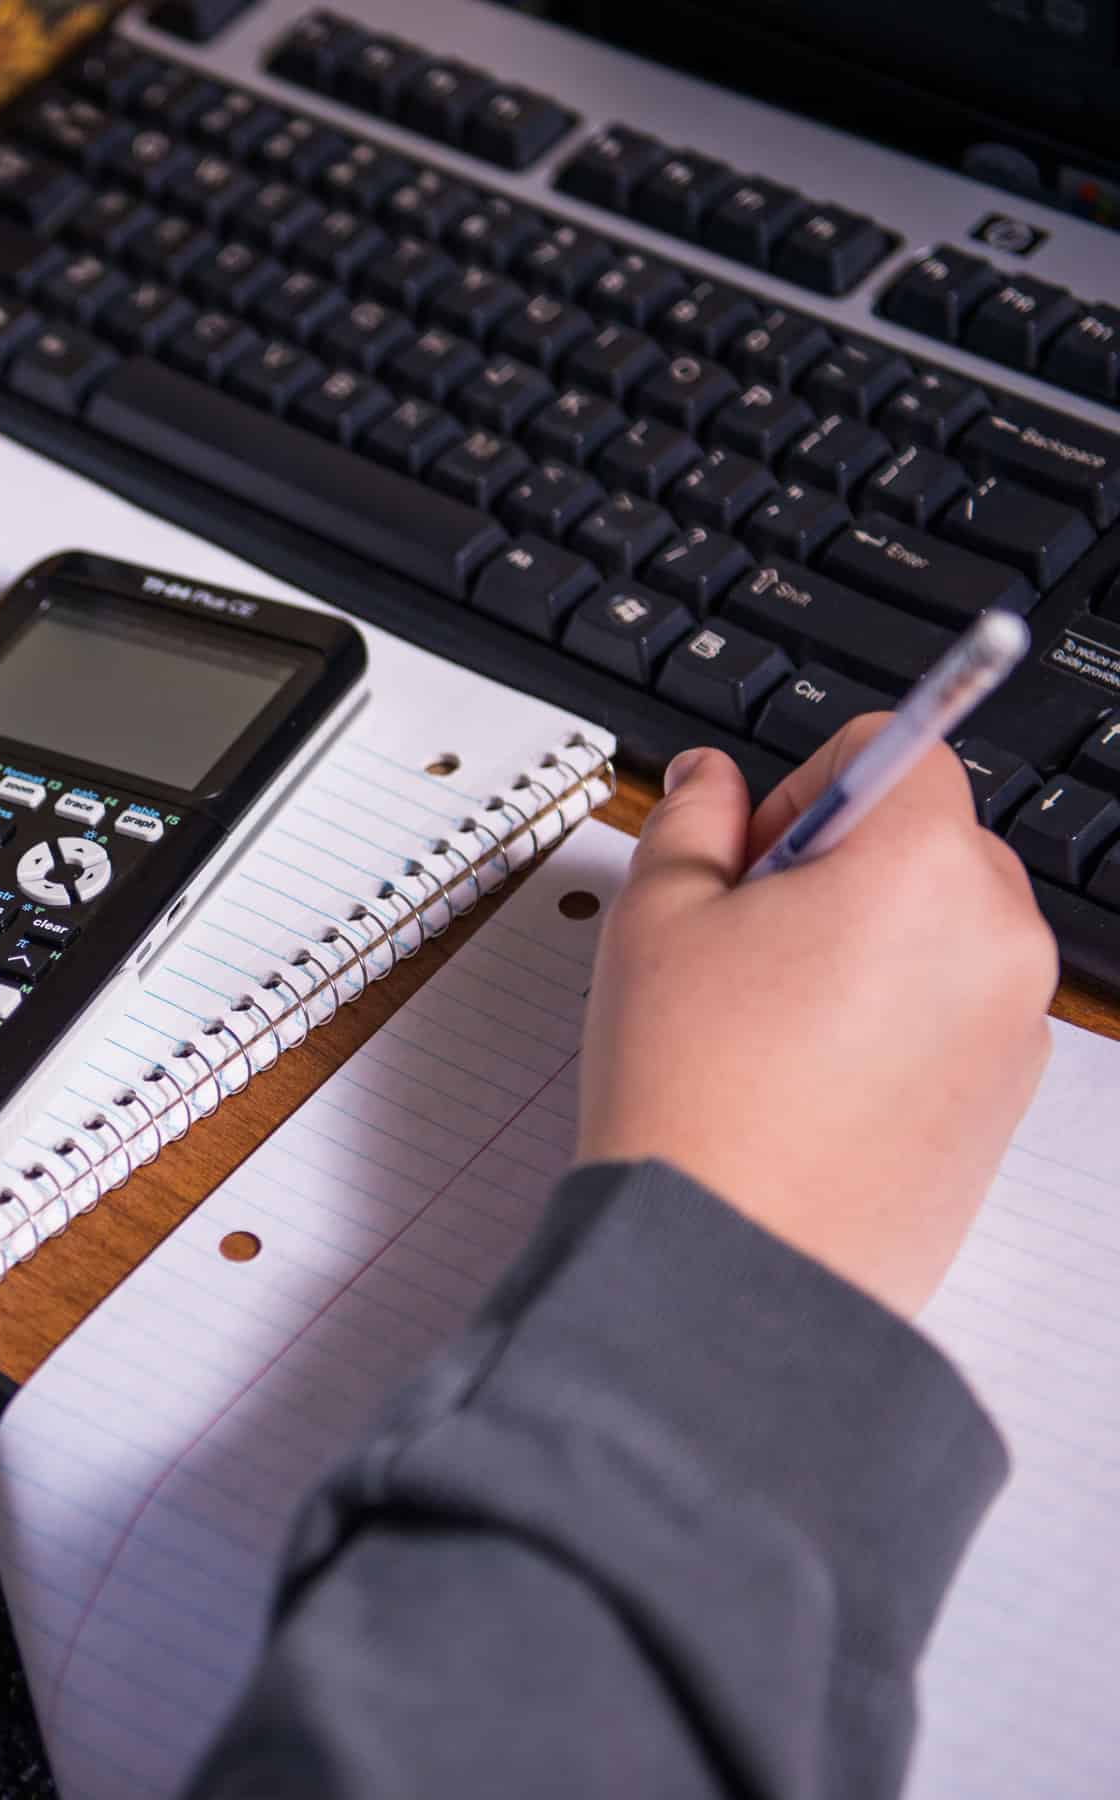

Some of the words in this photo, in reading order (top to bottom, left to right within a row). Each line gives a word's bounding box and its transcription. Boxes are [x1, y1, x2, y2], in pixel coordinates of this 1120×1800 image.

[886, 542, 928, 568] Enter
[795, 680, 826, 703] Ctrl
[64, 798, 94, 811] trace
[130, 803, 161, 818] table
[122, 813, 156, 830] graph
[32, 917, 69, 935] clear
[49, 950, 63, 961] H
